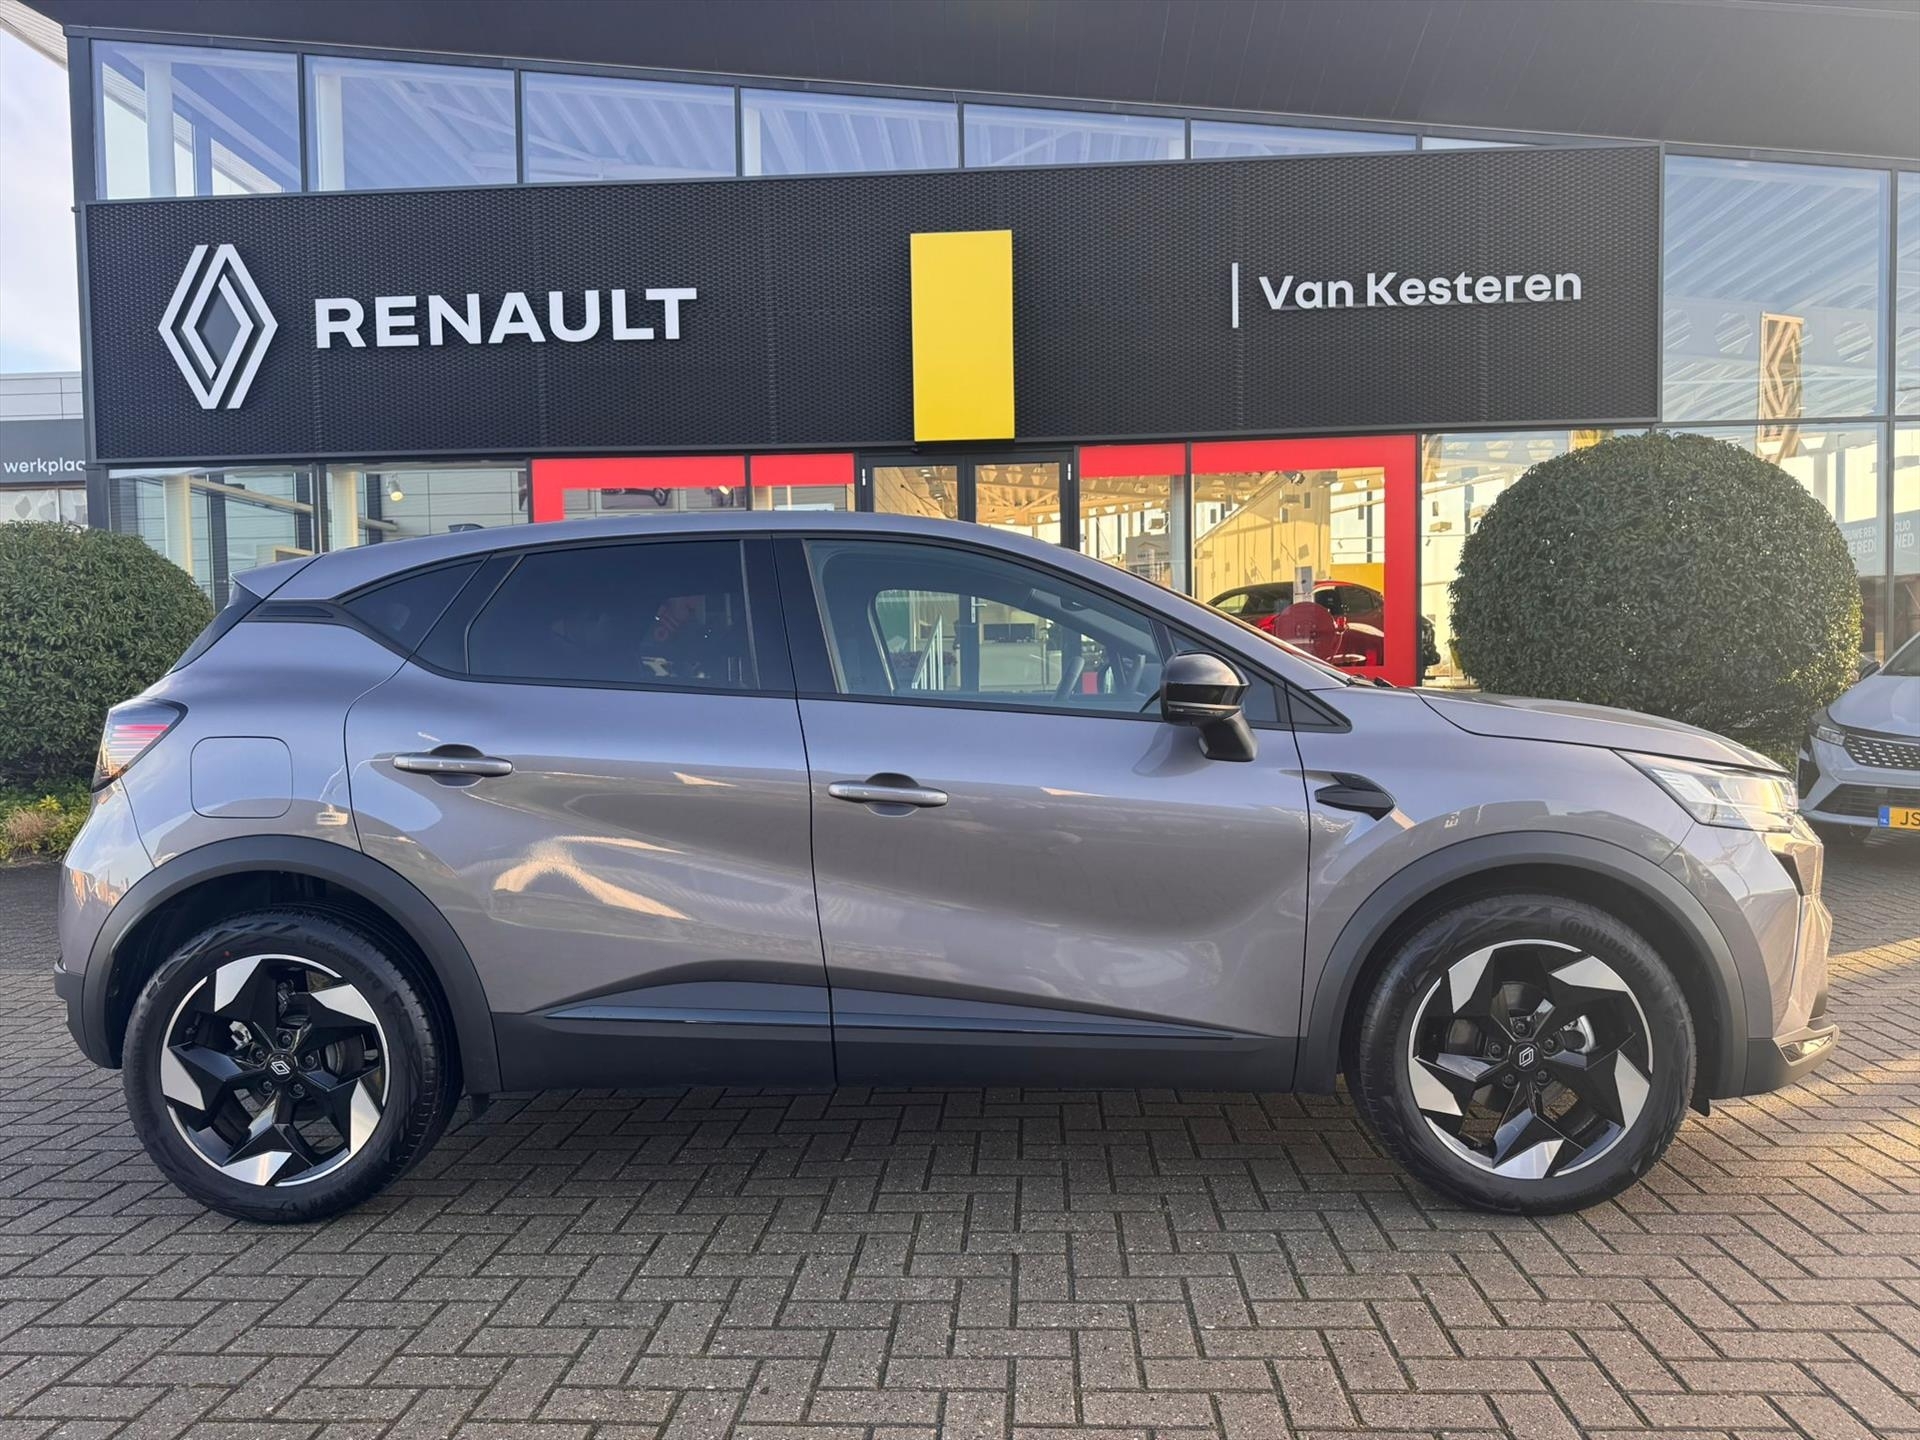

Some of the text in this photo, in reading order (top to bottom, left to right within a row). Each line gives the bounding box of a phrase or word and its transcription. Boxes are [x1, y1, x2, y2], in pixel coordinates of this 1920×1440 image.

[1258, 271, 1582, 310] Van Kesteren
[314, 287, 698, 349] RENAULT
[1900, 810, 1920, 826] JS
